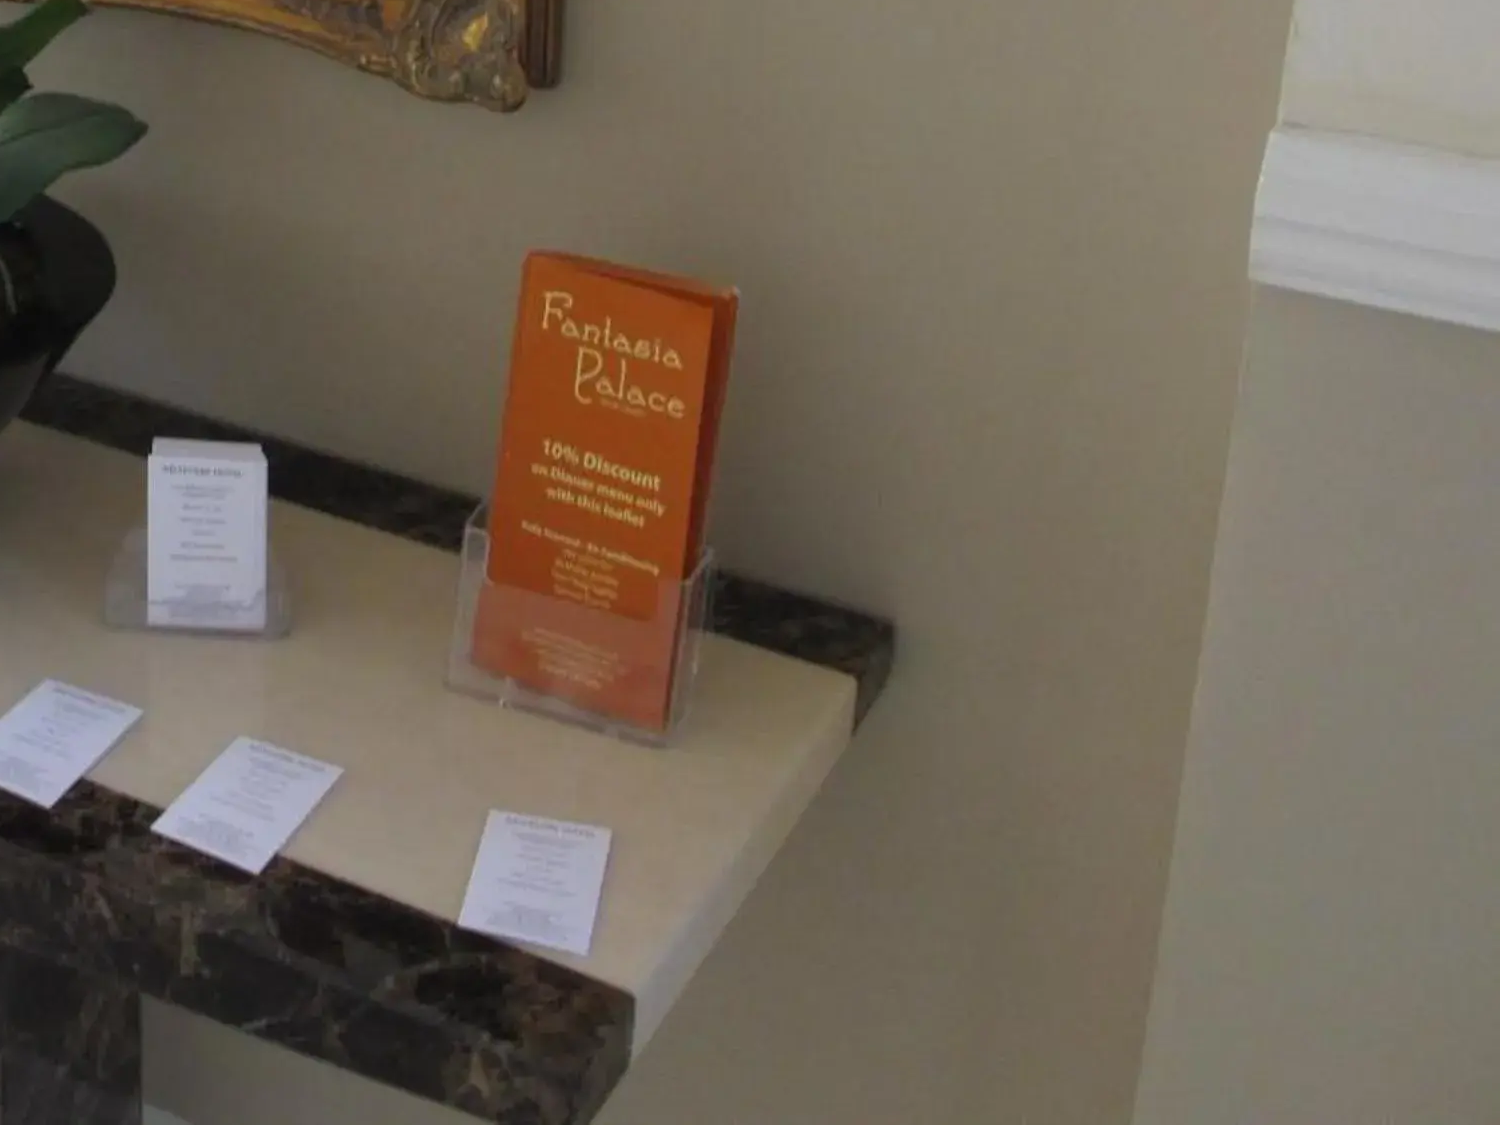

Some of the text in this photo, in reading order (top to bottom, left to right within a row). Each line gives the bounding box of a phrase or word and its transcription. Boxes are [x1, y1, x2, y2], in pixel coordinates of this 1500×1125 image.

[541, 290, 684, 371] Fantasia
[574, 346, 686, 419] Palace
[542, 437, 662, 492] 10% Discount
